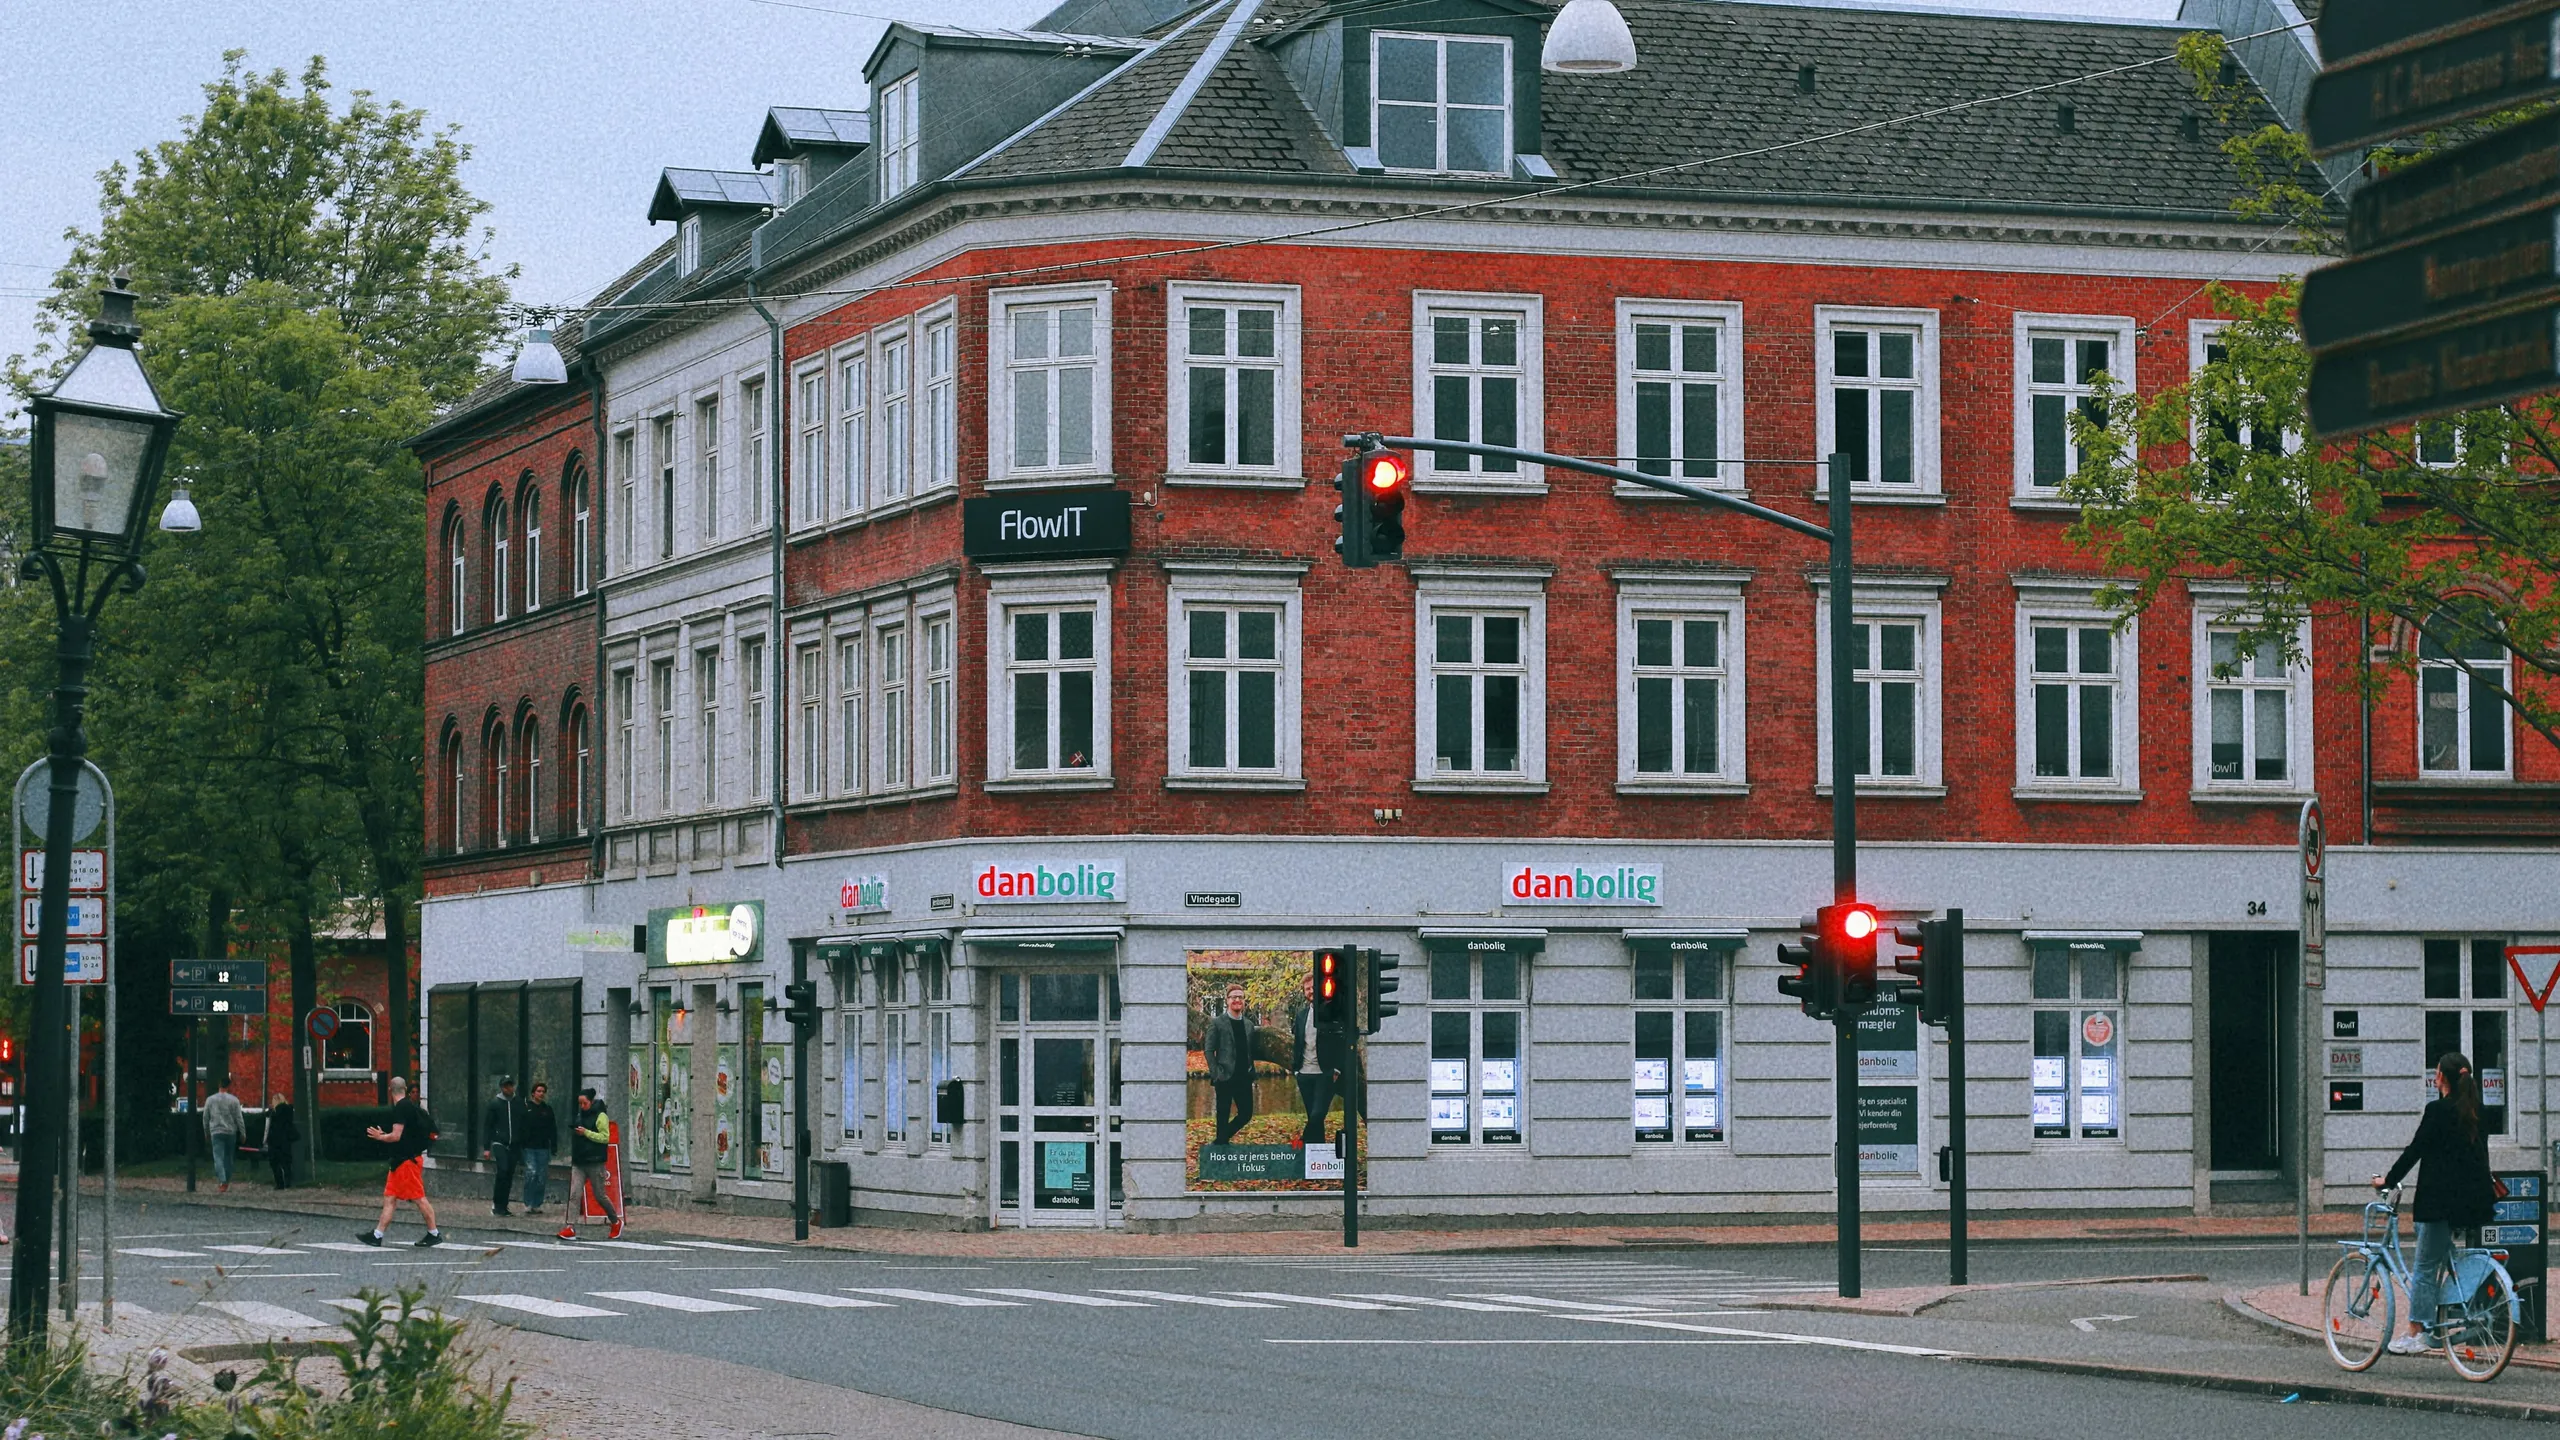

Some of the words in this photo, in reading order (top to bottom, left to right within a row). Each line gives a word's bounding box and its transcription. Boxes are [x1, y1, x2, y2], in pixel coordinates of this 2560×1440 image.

[1001, 506, 1087, 540] FlowIT
[2212, 762, 2238, 773] lowIT
[977, 864, 1116, 900] danbolig
[1512, 867, 1657, 903] danbolig
[841, 875, 884, 908] danbolig
[1190, 895, 1236, 905] Vindegade
[2247, 900, 2267, 915] 34
[1467, 940, 1506, 951] danbolig
[1670, 940, 1708, 950] danbolig
[218, 971, 229, 983] 12
[1877, 991, 1897, 1002] okal
[1858, 1019, 1897, 1032] mægler
[1859, 1057, 1898, 1067] danbolig
[2331, 1053, 2361, 1064] DATS
[2483, 1079, 2504, 1088] DATS
[1877, 1097, 1908, 1107] specialist
[1867, 1109, 1890, 1117] kender
[1891, 1109, 1902, 1117] din
[1209, 1152, 1226, 1161] Hos
[1249, 1152, 1269, 1162] jeres
[1270, 1152, 1296, 1160] behov
[1859, 1151, 1898, 1160] danbolig
[1237, 1163, 1241, 1172] i
[1242, 1163, 1266, 1172] fokus
[1310, 1161, 1344, 1170] danboli
[1051, 1196, 1080, 1205] danbolig
